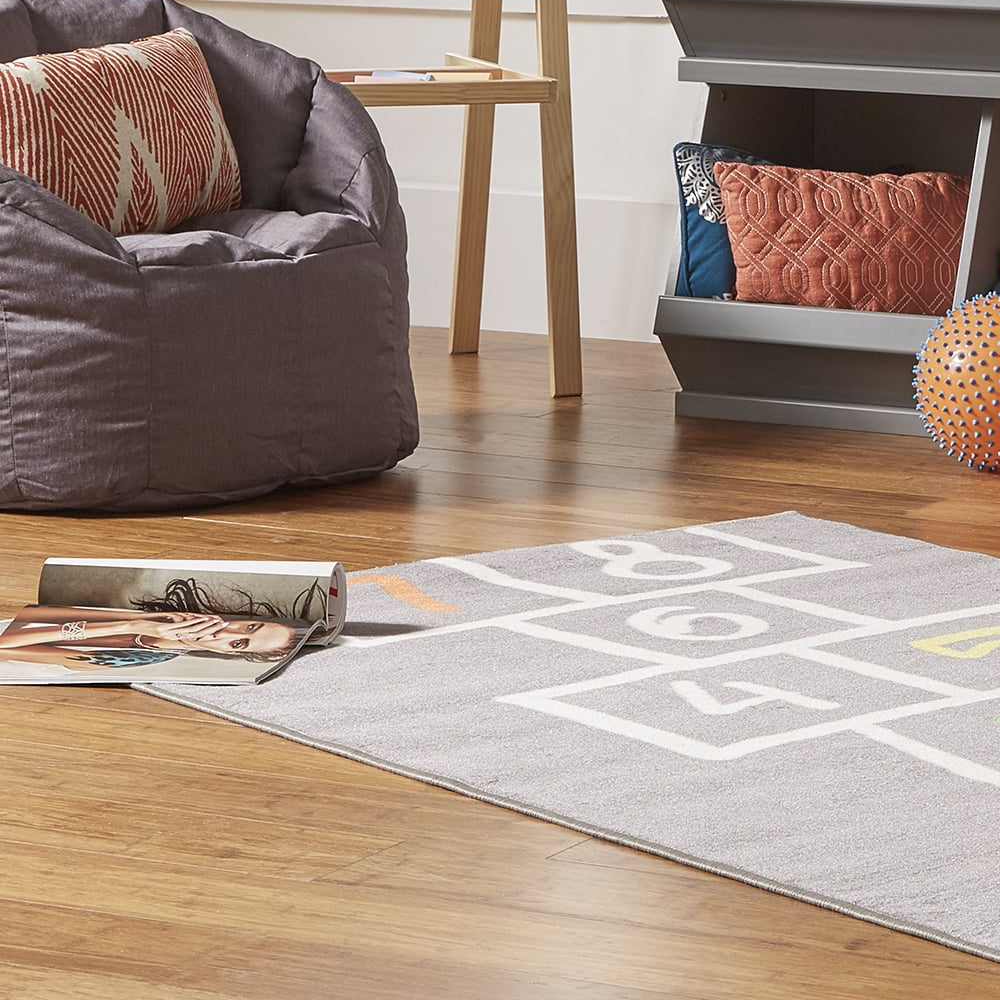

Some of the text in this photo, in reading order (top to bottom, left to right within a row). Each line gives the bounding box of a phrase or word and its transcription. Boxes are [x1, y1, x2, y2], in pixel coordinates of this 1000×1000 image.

[568, 540, 734, 580] 8
[626, 606, 769, 640] 6
[671, 681, 842, 715] 4
